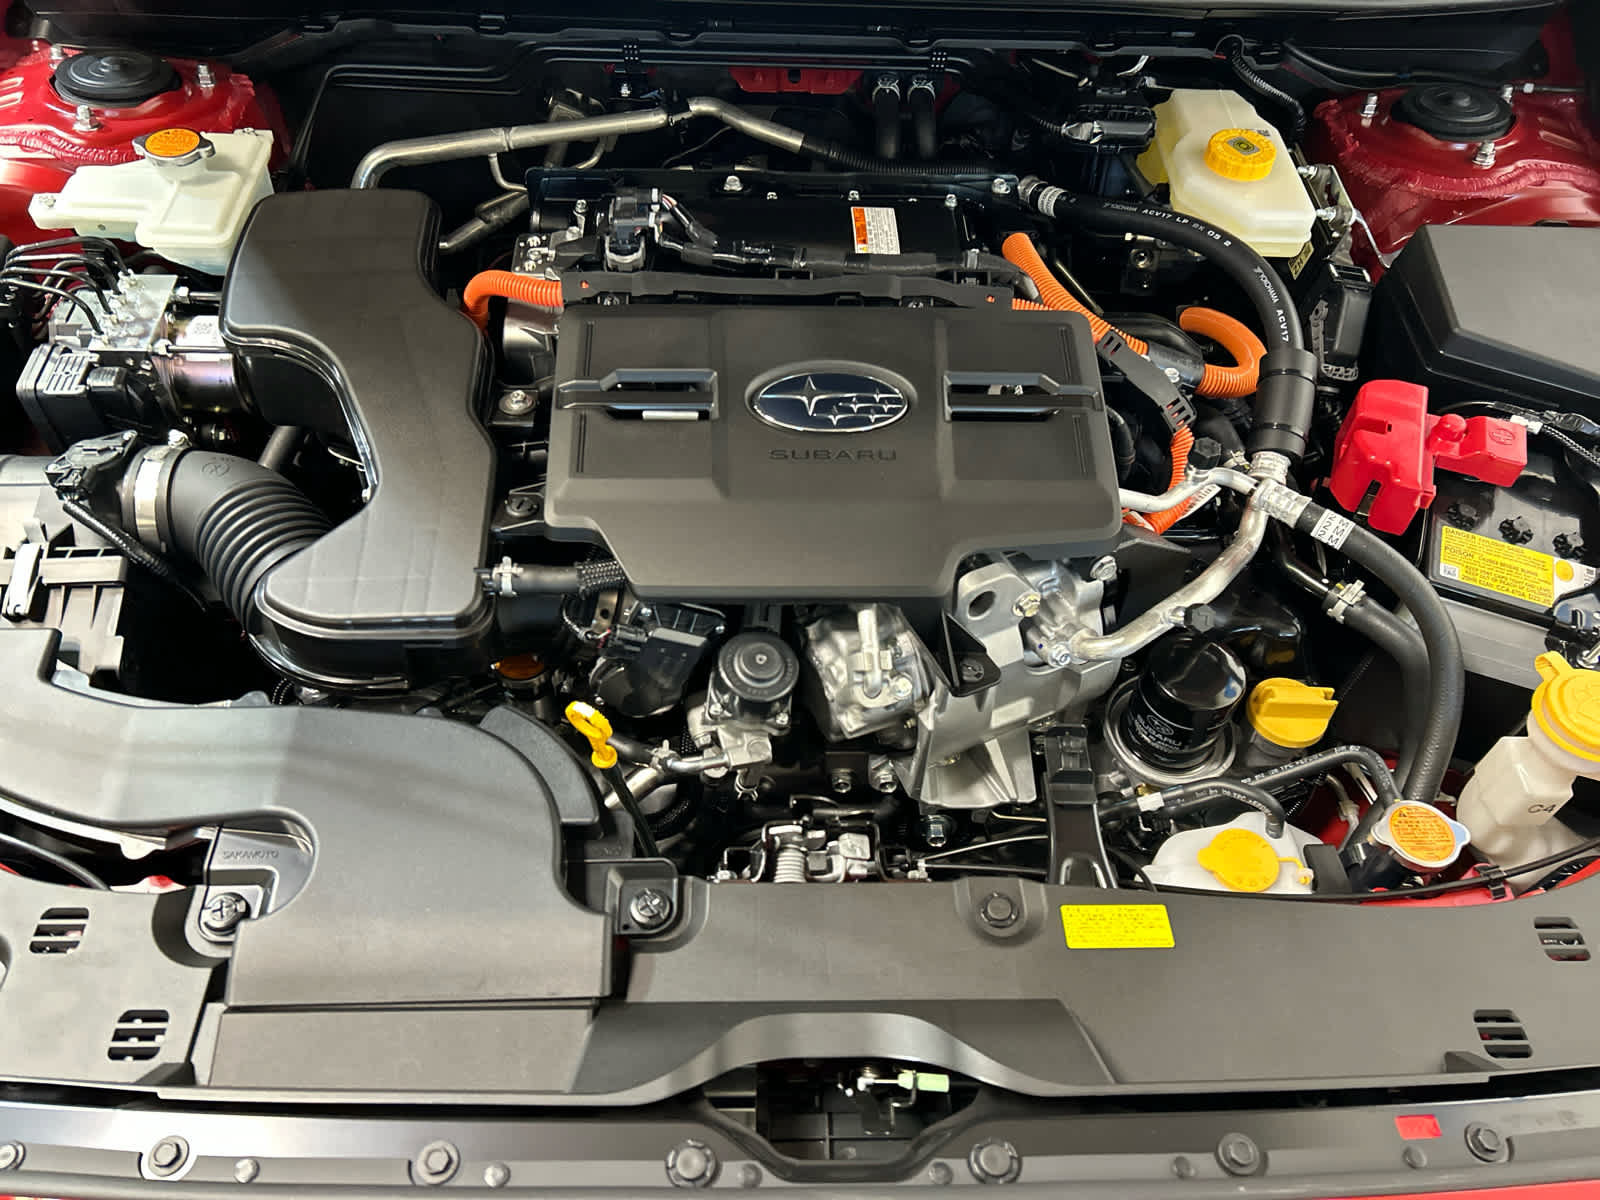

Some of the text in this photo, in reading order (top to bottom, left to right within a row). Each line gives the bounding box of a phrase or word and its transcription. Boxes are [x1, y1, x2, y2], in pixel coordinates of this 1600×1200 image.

[1142, 208, 1172, 219] ACV17
[1176, 216, 1189, 224] LP
[1276, 309, 1290, 342] ACV17
[769, 449, 897, 461] SUBARU
[1328, 513, 1350, 528] 2 M
[1323, 521, 1345, 537] 2 M
[1318, 530, 1340, 545] 2 M
[1445, 546, 1473, 558] POISON
[1528, 804, 1557, 814] C4
